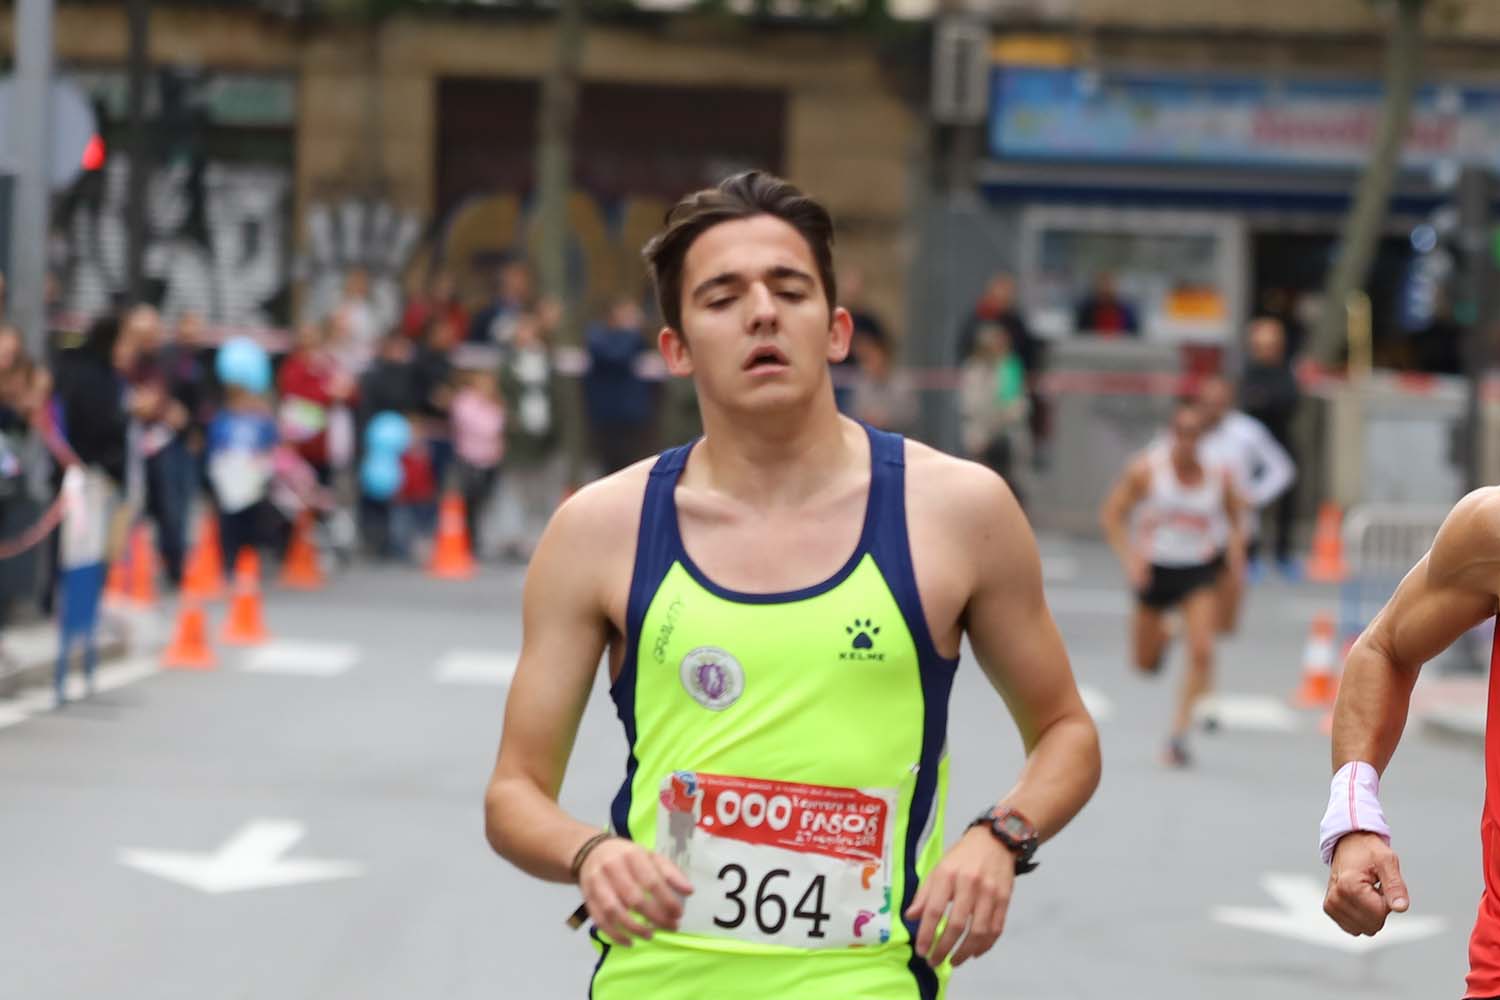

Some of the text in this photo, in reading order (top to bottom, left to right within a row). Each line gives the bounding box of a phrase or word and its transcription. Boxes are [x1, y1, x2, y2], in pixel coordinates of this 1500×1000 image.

[839, 652, 885, 661] KELME
[800, 810, 879, 836] PASOS
[713, 863, 830, 938] 364
